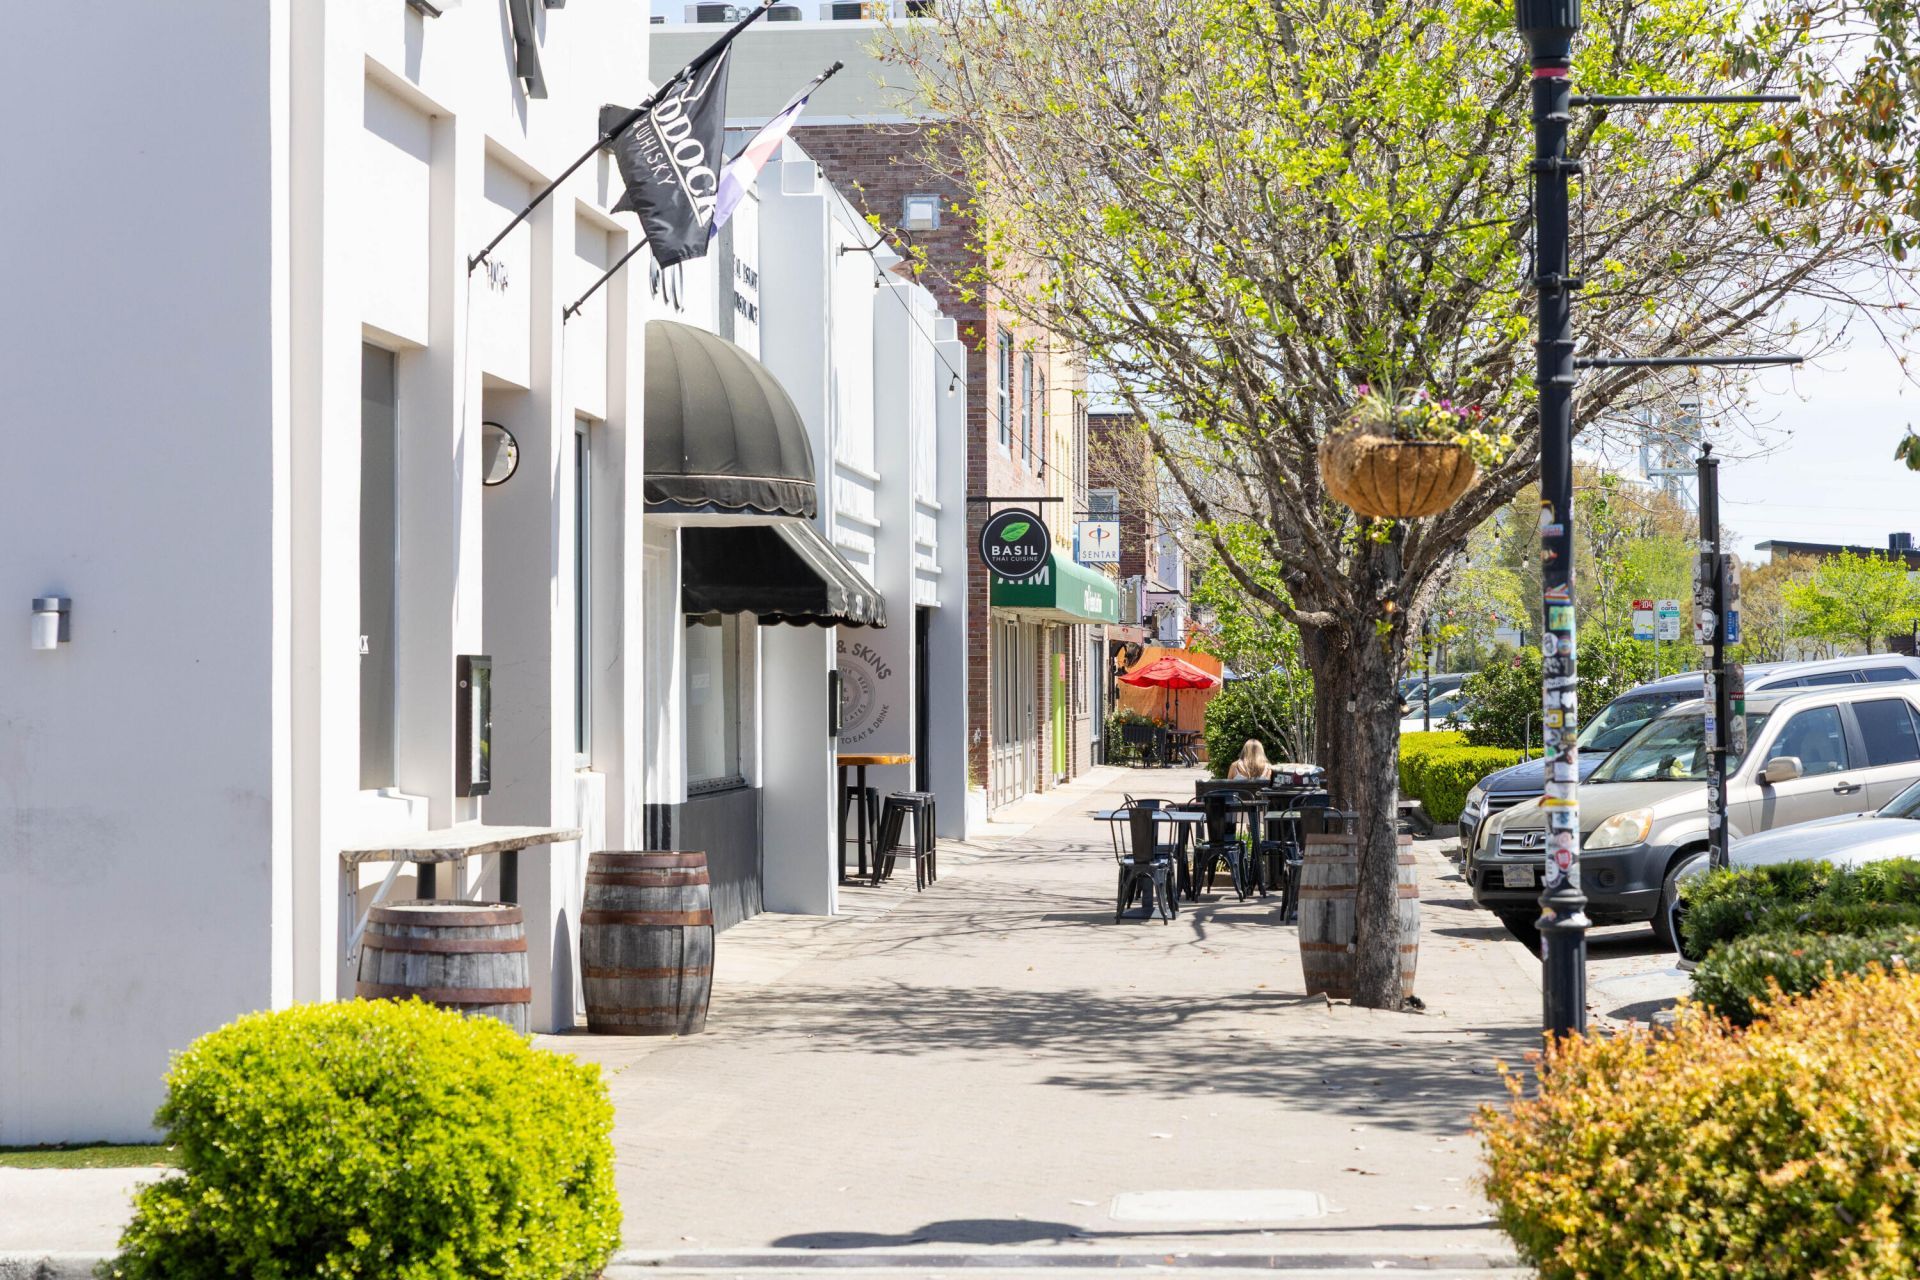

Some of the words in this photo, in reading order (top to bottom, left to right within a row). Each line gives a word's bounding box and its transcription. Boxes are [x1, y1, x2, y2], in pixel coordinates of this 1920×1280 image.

[635, 125, 676, 187] WHISKY
[991, 545, 1038, 556] BASIL
[1082, 550, 1117, 559] SENTAR
[851, 643, 892, 680] SKINS
[852, 730, 866, 743] EAT
[873, 703, 890, 729] DRINK
